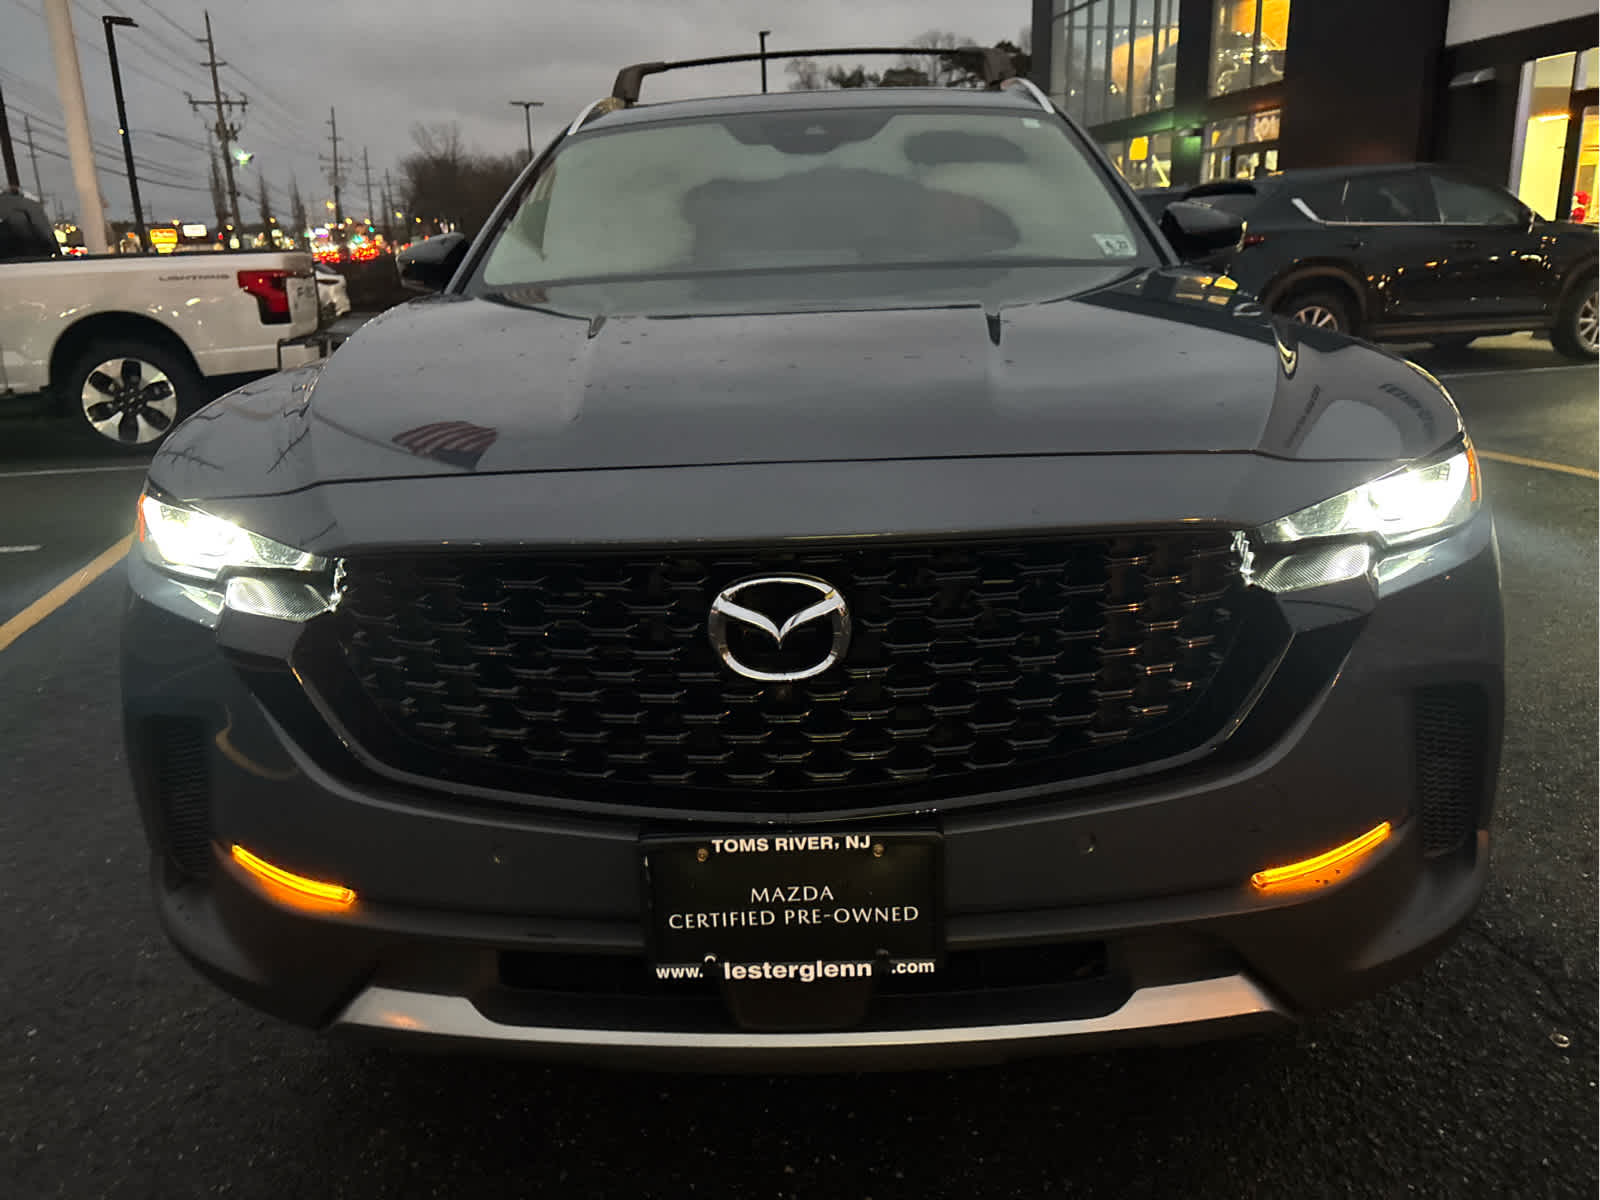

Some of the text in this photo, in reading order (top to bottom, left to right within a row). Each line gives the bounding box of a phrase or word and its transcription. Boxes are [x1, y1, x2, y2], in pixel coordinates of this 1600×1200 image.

[711, 833, 871, 854] TOMS RIVER, NJ
[751, 885, 834, 904] MAZDA
[668, 906, 919, 929] CERTIFIED PRE-OWNED
[655, 960, 935, 983] www. lesterglenn .com
